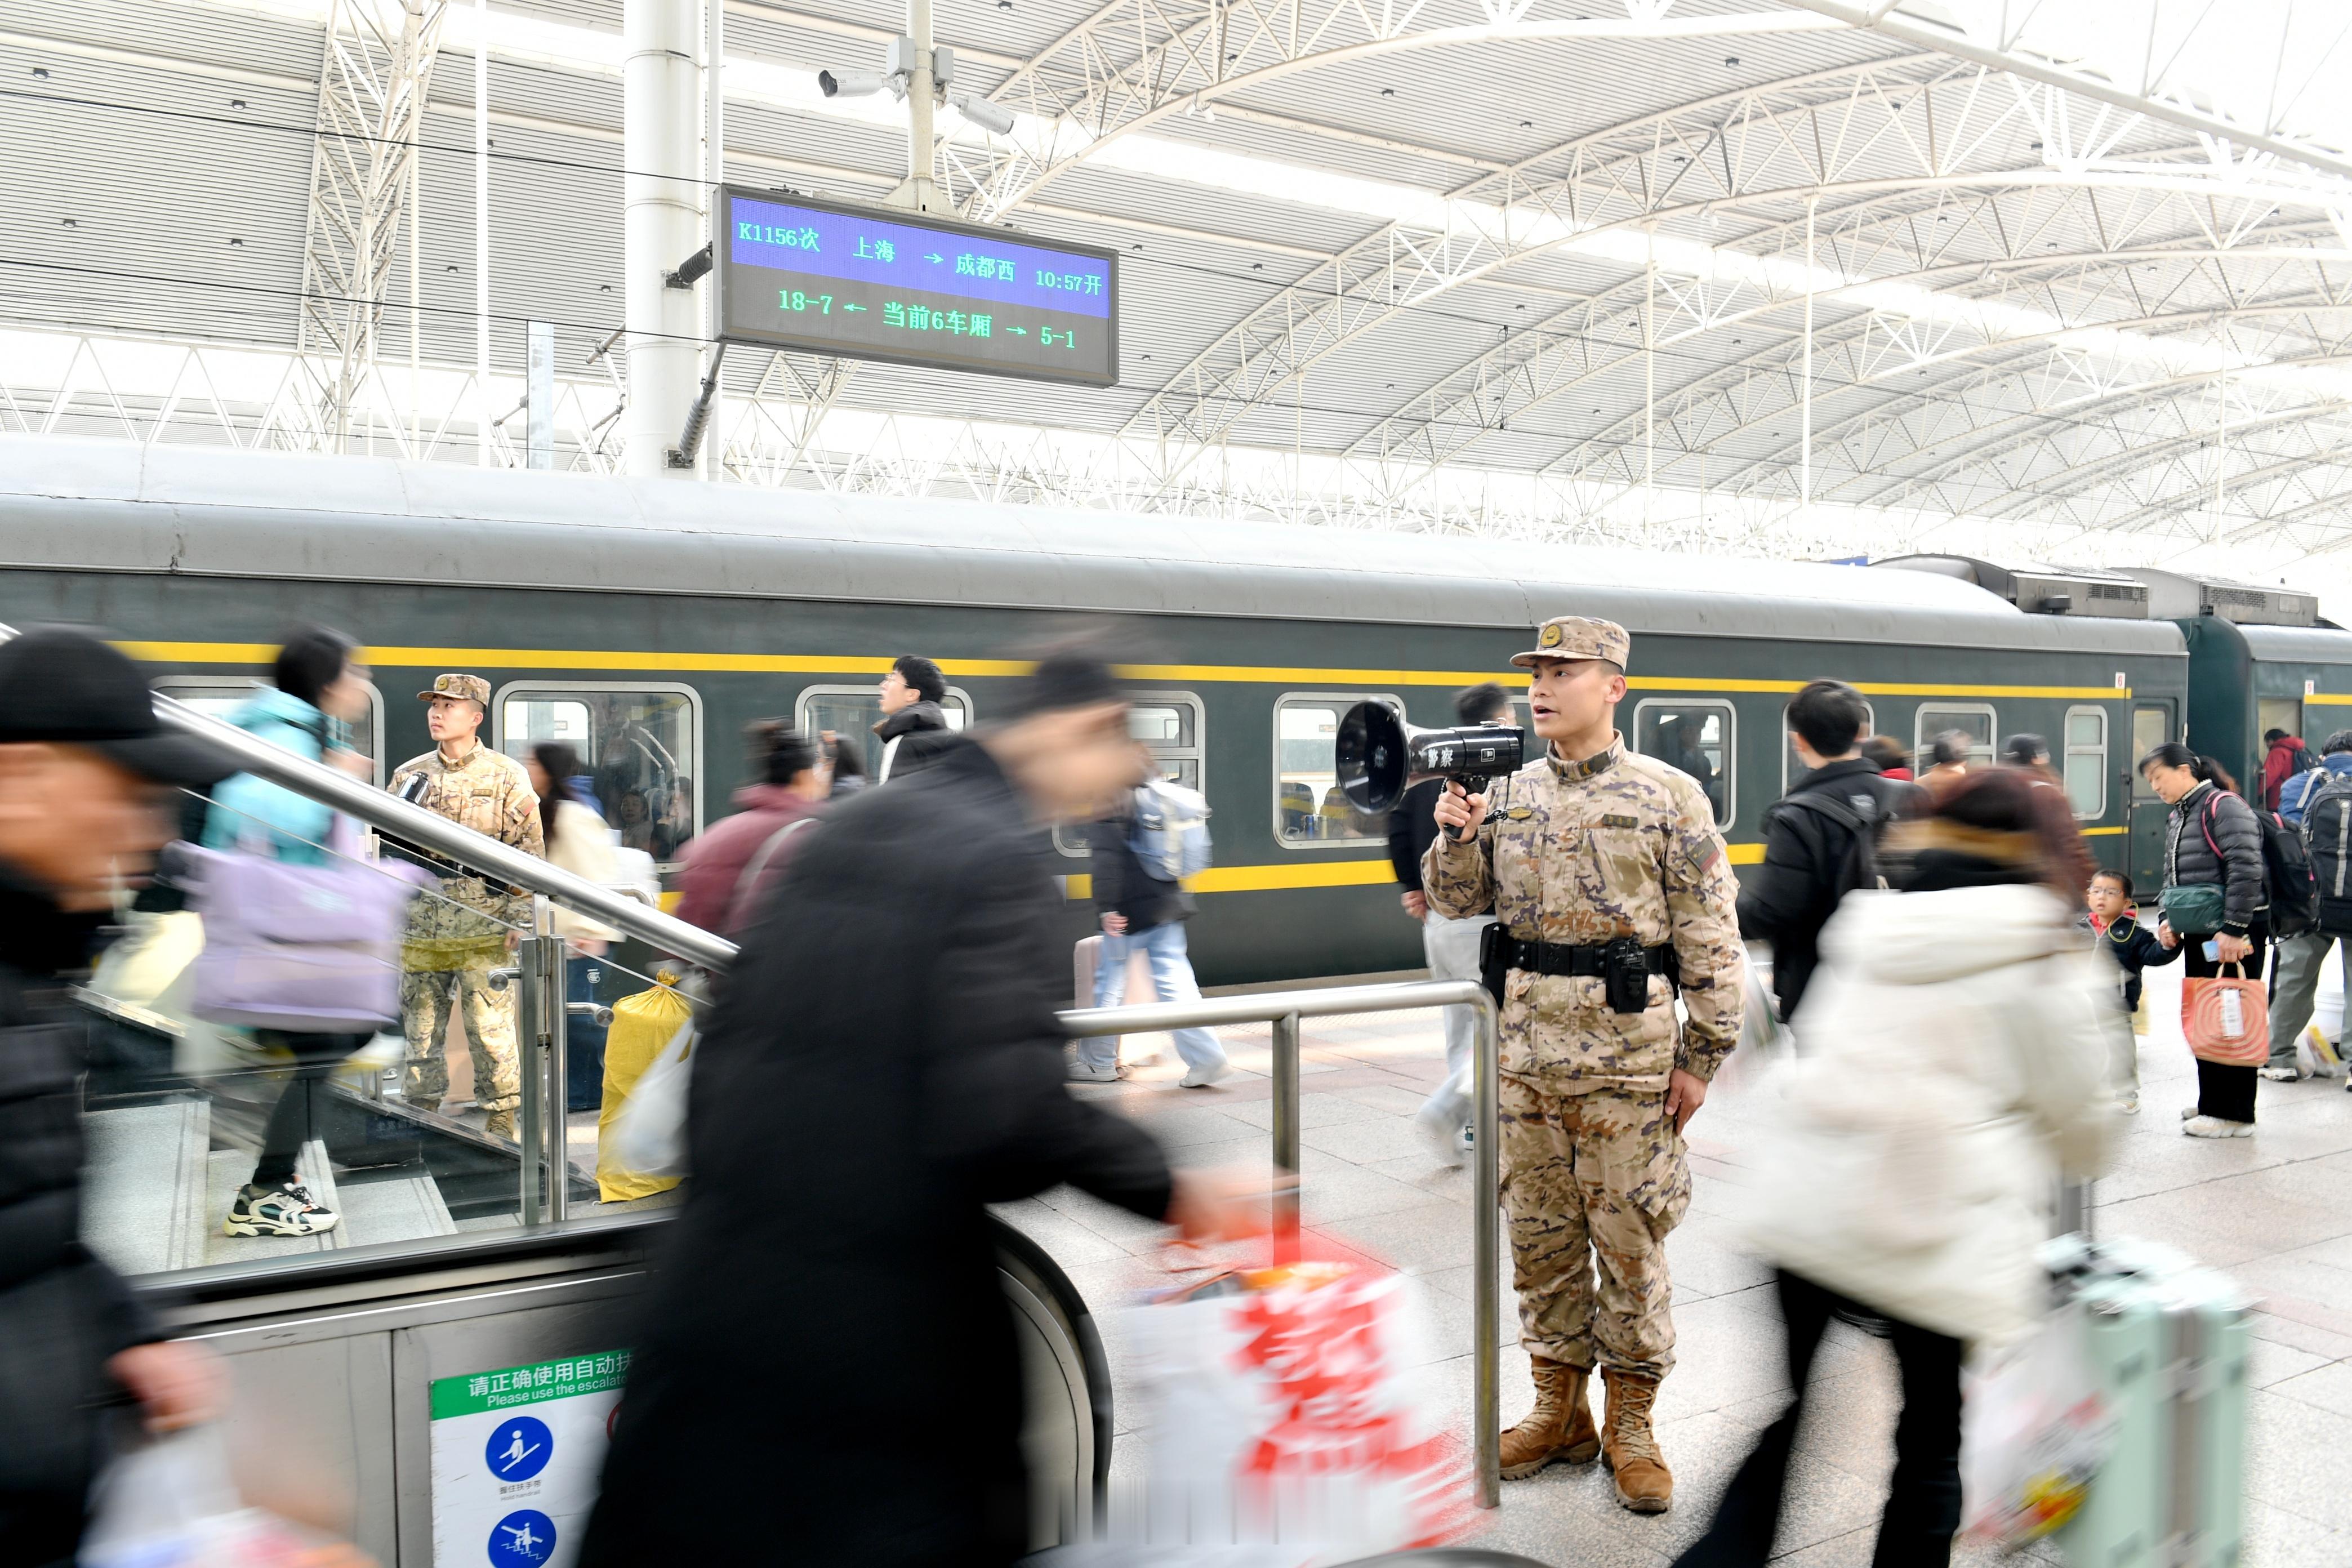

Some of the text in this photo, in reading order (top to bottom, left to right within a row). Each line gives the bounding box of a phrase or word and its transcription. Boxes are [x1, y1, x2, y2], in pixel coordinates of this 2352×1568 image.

[738, 222, 1102, 296] K1156次 上海 成都西 10:57开
[779, 289, 1075, 349] 18-7 当前6车厢 5-1
[2118, 675, 2123, 687] 6
[1428, 747, 1454, 769] 警察
[487, 1392, 529, 1407] Please
[532, 1388, 554, 1400] use
[555, 1384, 575, 1396] the
